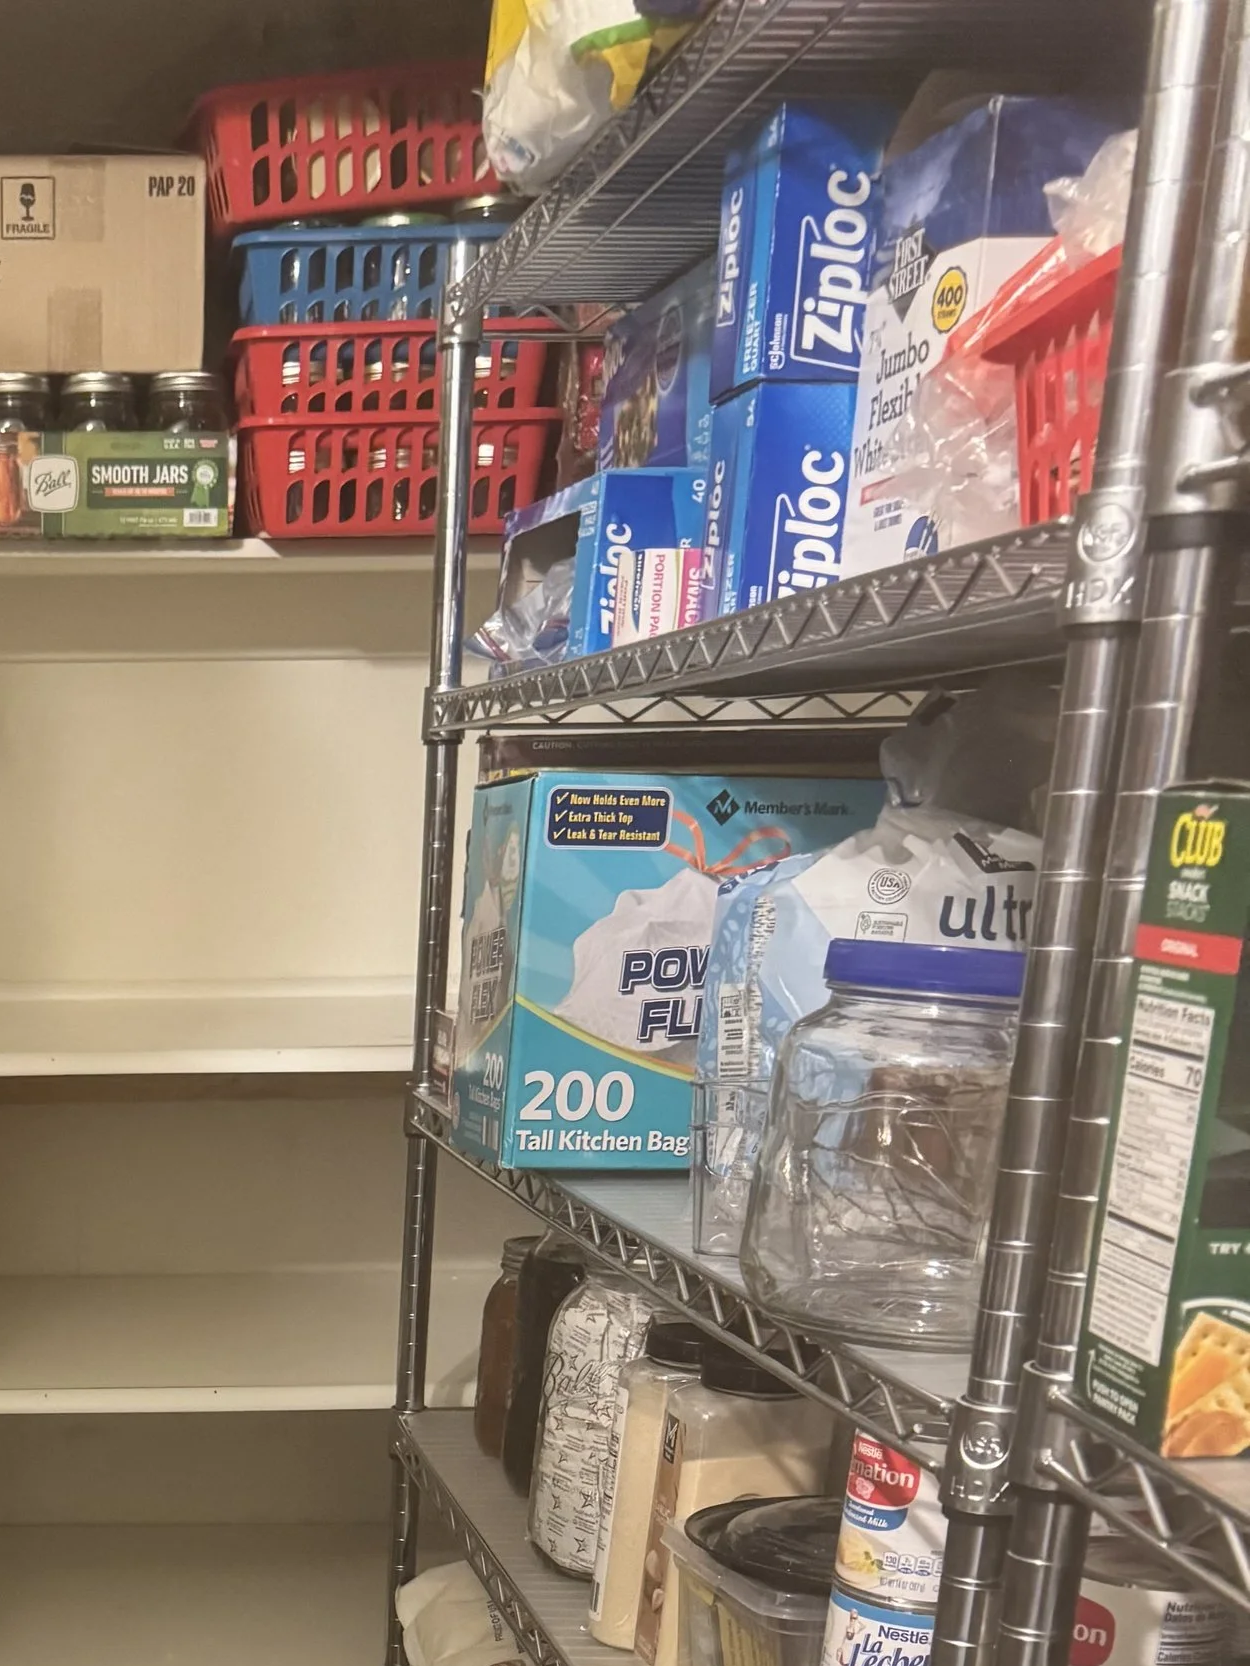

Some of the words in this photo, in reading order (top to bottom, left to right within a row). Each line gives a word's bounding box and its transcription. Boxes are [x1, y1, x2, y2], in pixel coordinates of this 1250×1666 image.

[148, 175, 171, 197] PAP
[178, 175, 195, 197] 20
[5, 223, 50, 234] FRAGILE
[718, 187, 744, 321] Ziploc
[802, 169, 871, 354] Ziploc
[893, 227, 925, 269] FIRST
[887, 254, 928, 303] STREET
[936, 287, 962, 307] 400
[742, 281, 758, 374] FREEZER
[876, 334, 929, 385] Jumbo
[34, 468, 72, 497] Ball
[91, 464, 150, 485] SMOOTH
[152, 464, 189, 485] JARS
[778, 449, 844, 600] iploc
[651, 553, 666, 612] PORTION
[684, 567, 701, 628] SNAC
[570, 793, 591, 805] Now
[593, 794, 617, 805] Holds
[619, 794, 639, 806] Even
[641, 795, 666, 807] More
[744, 799, 812, 816] Member's
[814, 800, 849, 816] Mark
[568, 811, 591, 823] Extra
[593, 811, 617, 823] Thick
[618, 812, 634, 826] Top
[567, 828, 587, 840] Leak
[598, 829, 617, 841] Tear
[619, 829, 661, 841] Resistant
[1169, 811, 1227, 868] CLUB
[1167, 879, 1210, 904] SNACK
[482, 1051, 504, 1090] 200
[1184, 1064, 1202, 1088] 70
[518, 1069, 635, 1123] 200
[515, 1130, 560, 1152] Tall
[563, 1130, 645, 1153] Kitchen
[647, 1130, 690, 1156] Bag
[1208, 1240, 1241, 1256] TRY
[862, 1633, 883, 1654] La
